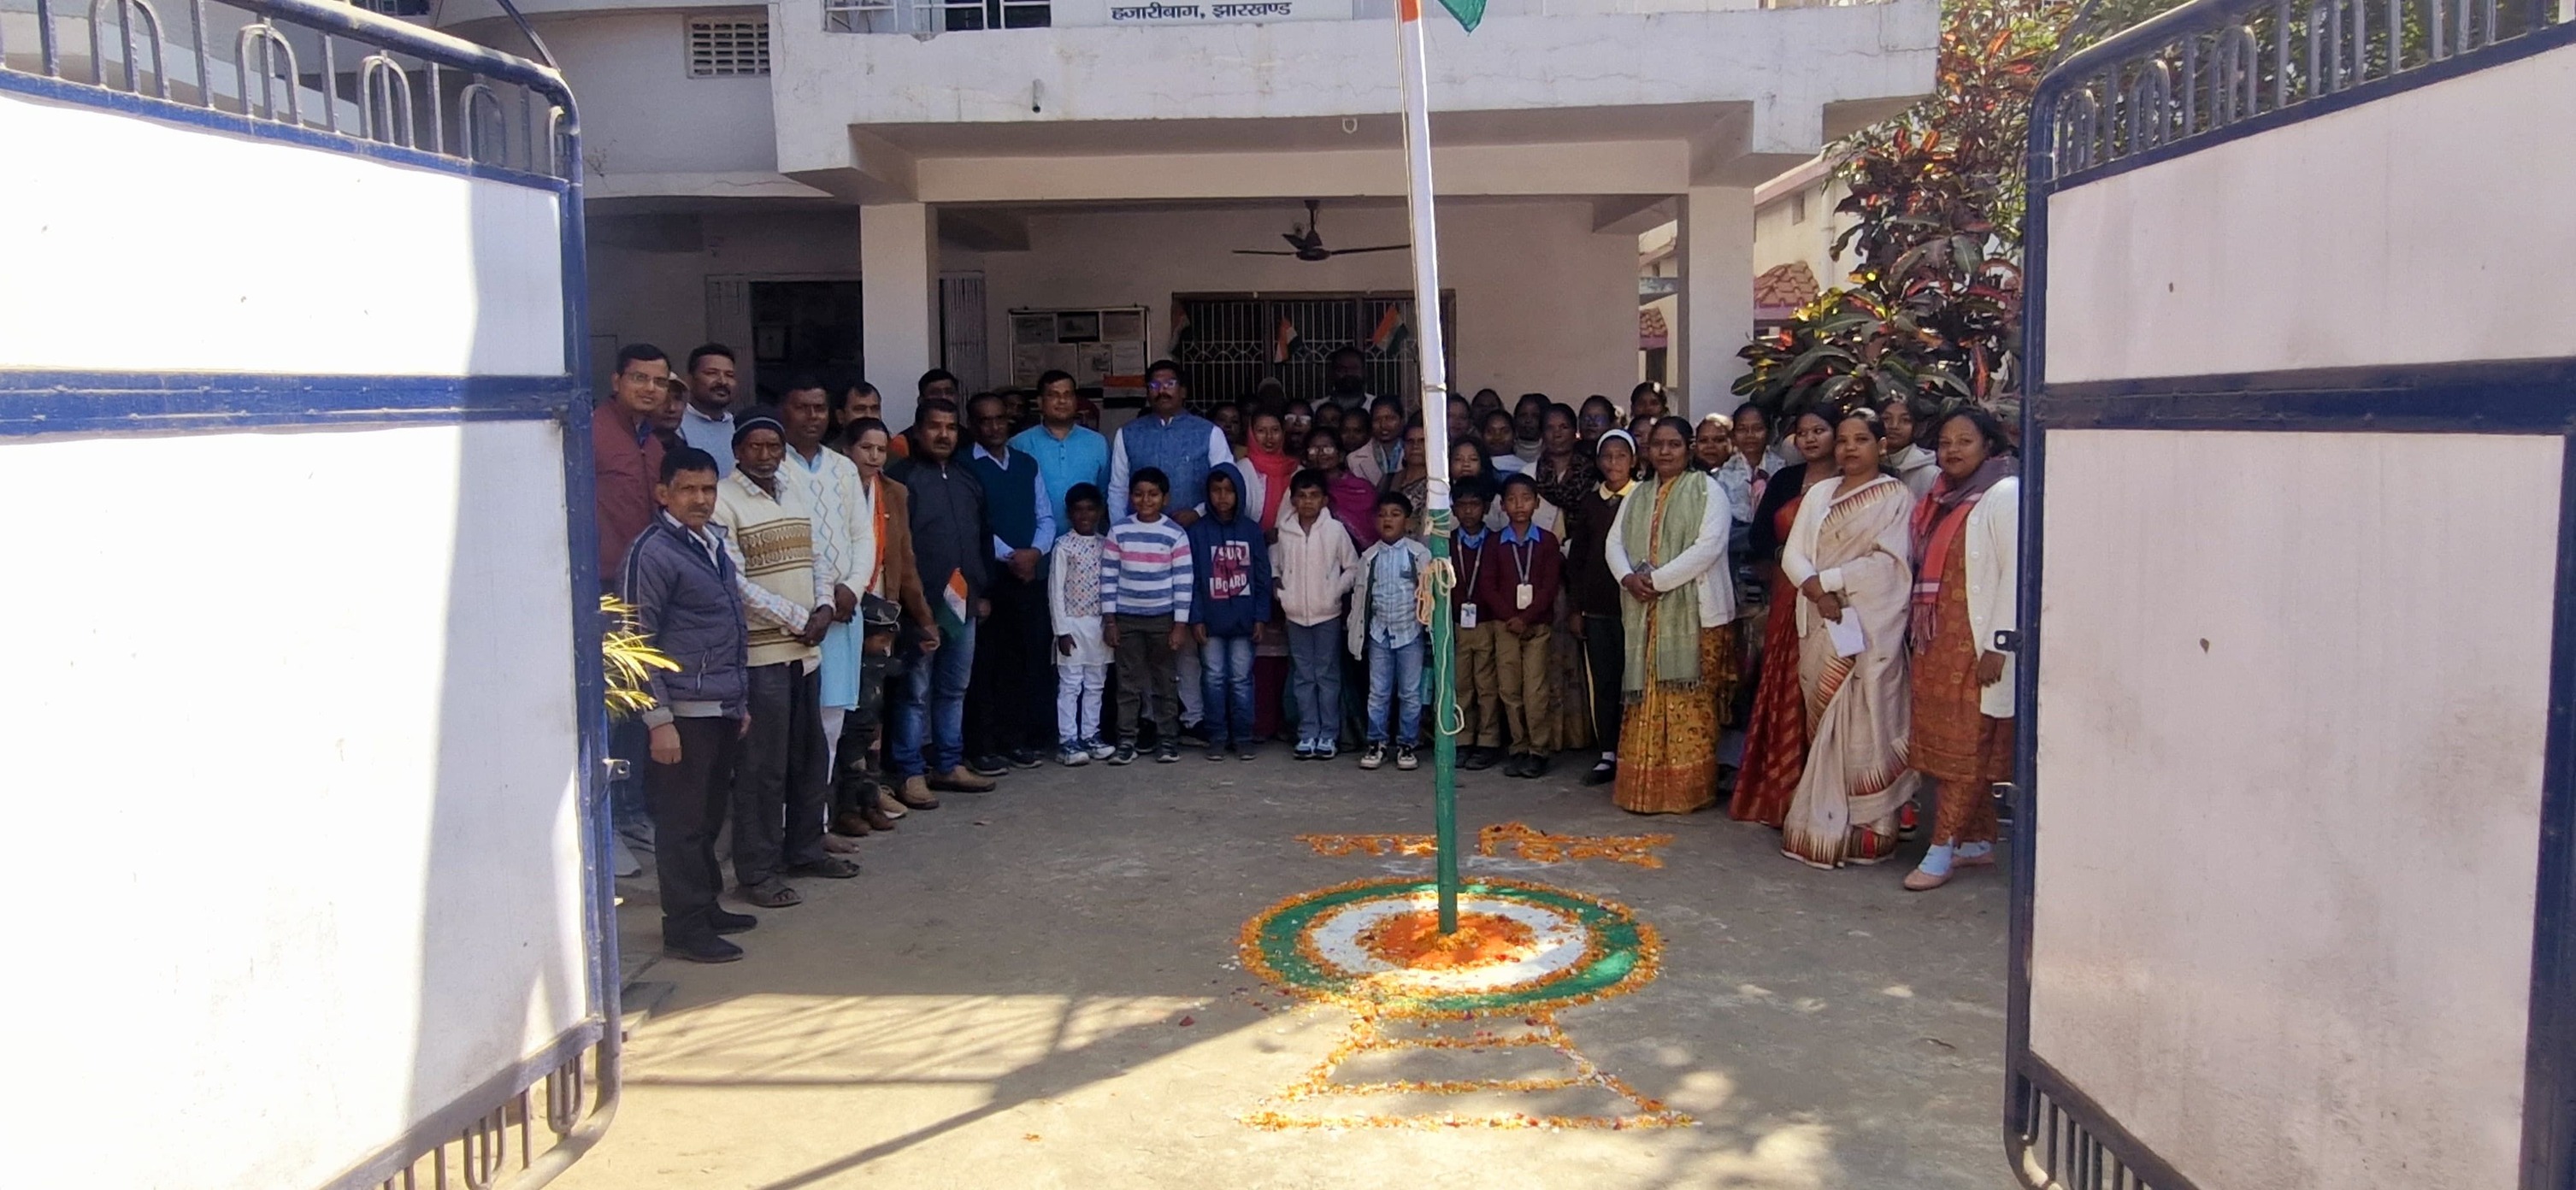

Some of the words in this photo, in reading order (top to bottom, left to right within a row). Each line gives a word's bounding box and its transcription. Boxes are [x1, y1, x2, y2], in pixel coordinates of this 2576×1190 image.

[1111, 2, 1205, 21] हजारीबाग,
[1211, 3, 1293, 19] झारखण्ड
[1215, 574, 1247, 592] BOARD
